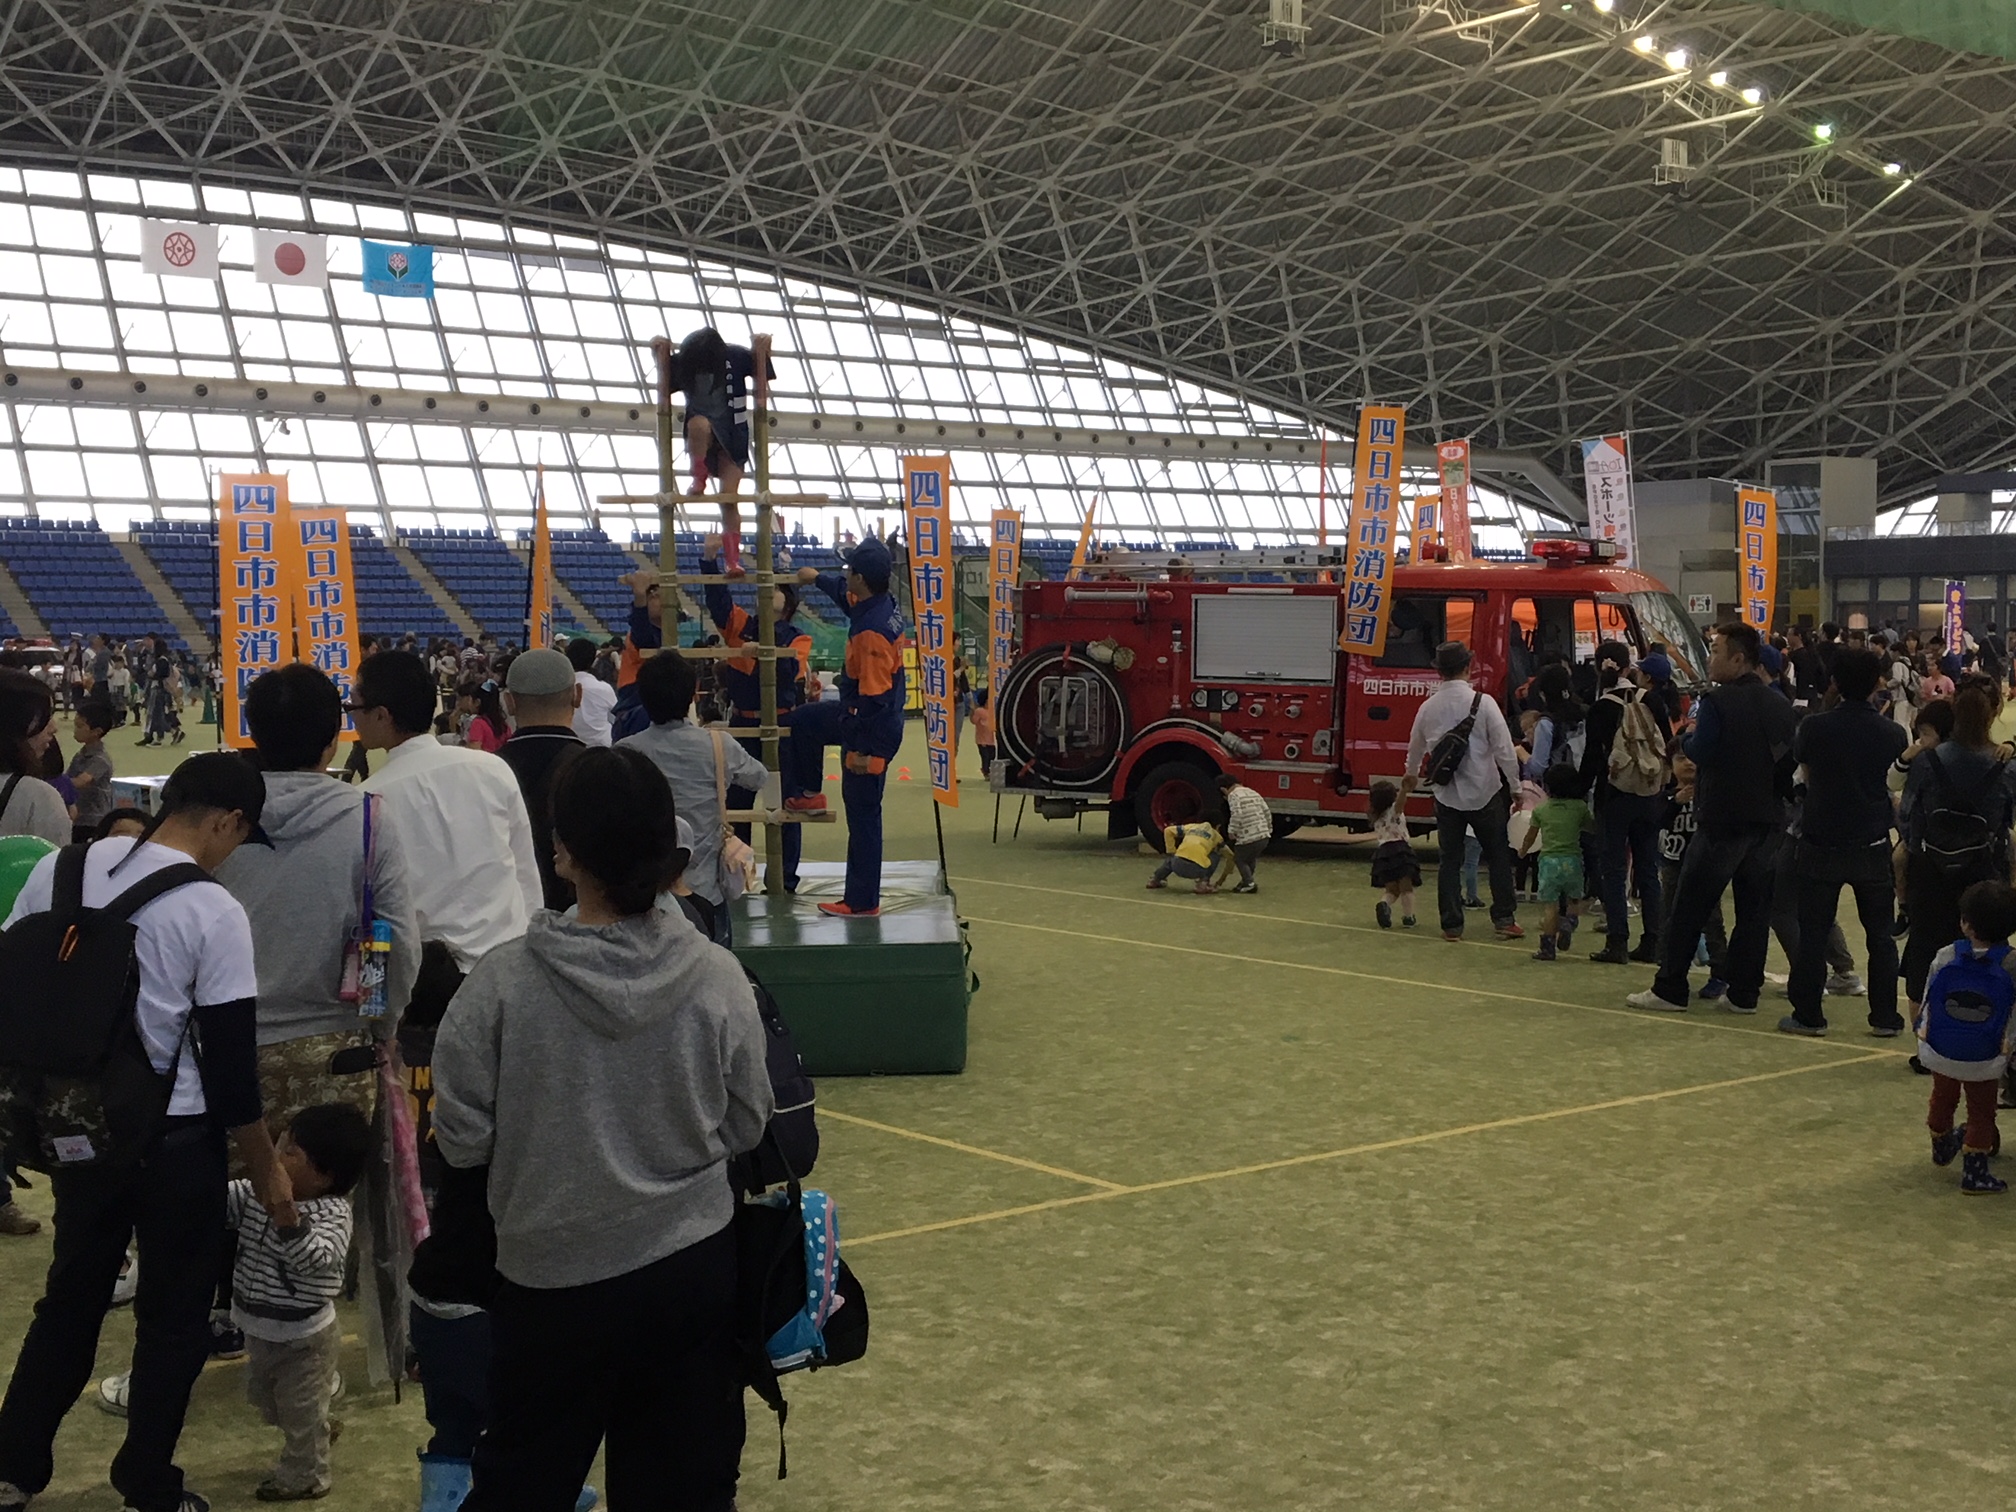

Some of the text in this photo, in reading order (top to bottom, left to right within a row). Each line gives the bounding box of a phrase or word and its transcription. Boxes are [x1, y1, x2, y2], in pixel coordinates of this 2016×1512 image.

[300, 518, 355, 731] 四日市市消
[909, 470, 950, 792] 四日市市消防団
[1344, 418, 1397, 645] 四日市市消防団
